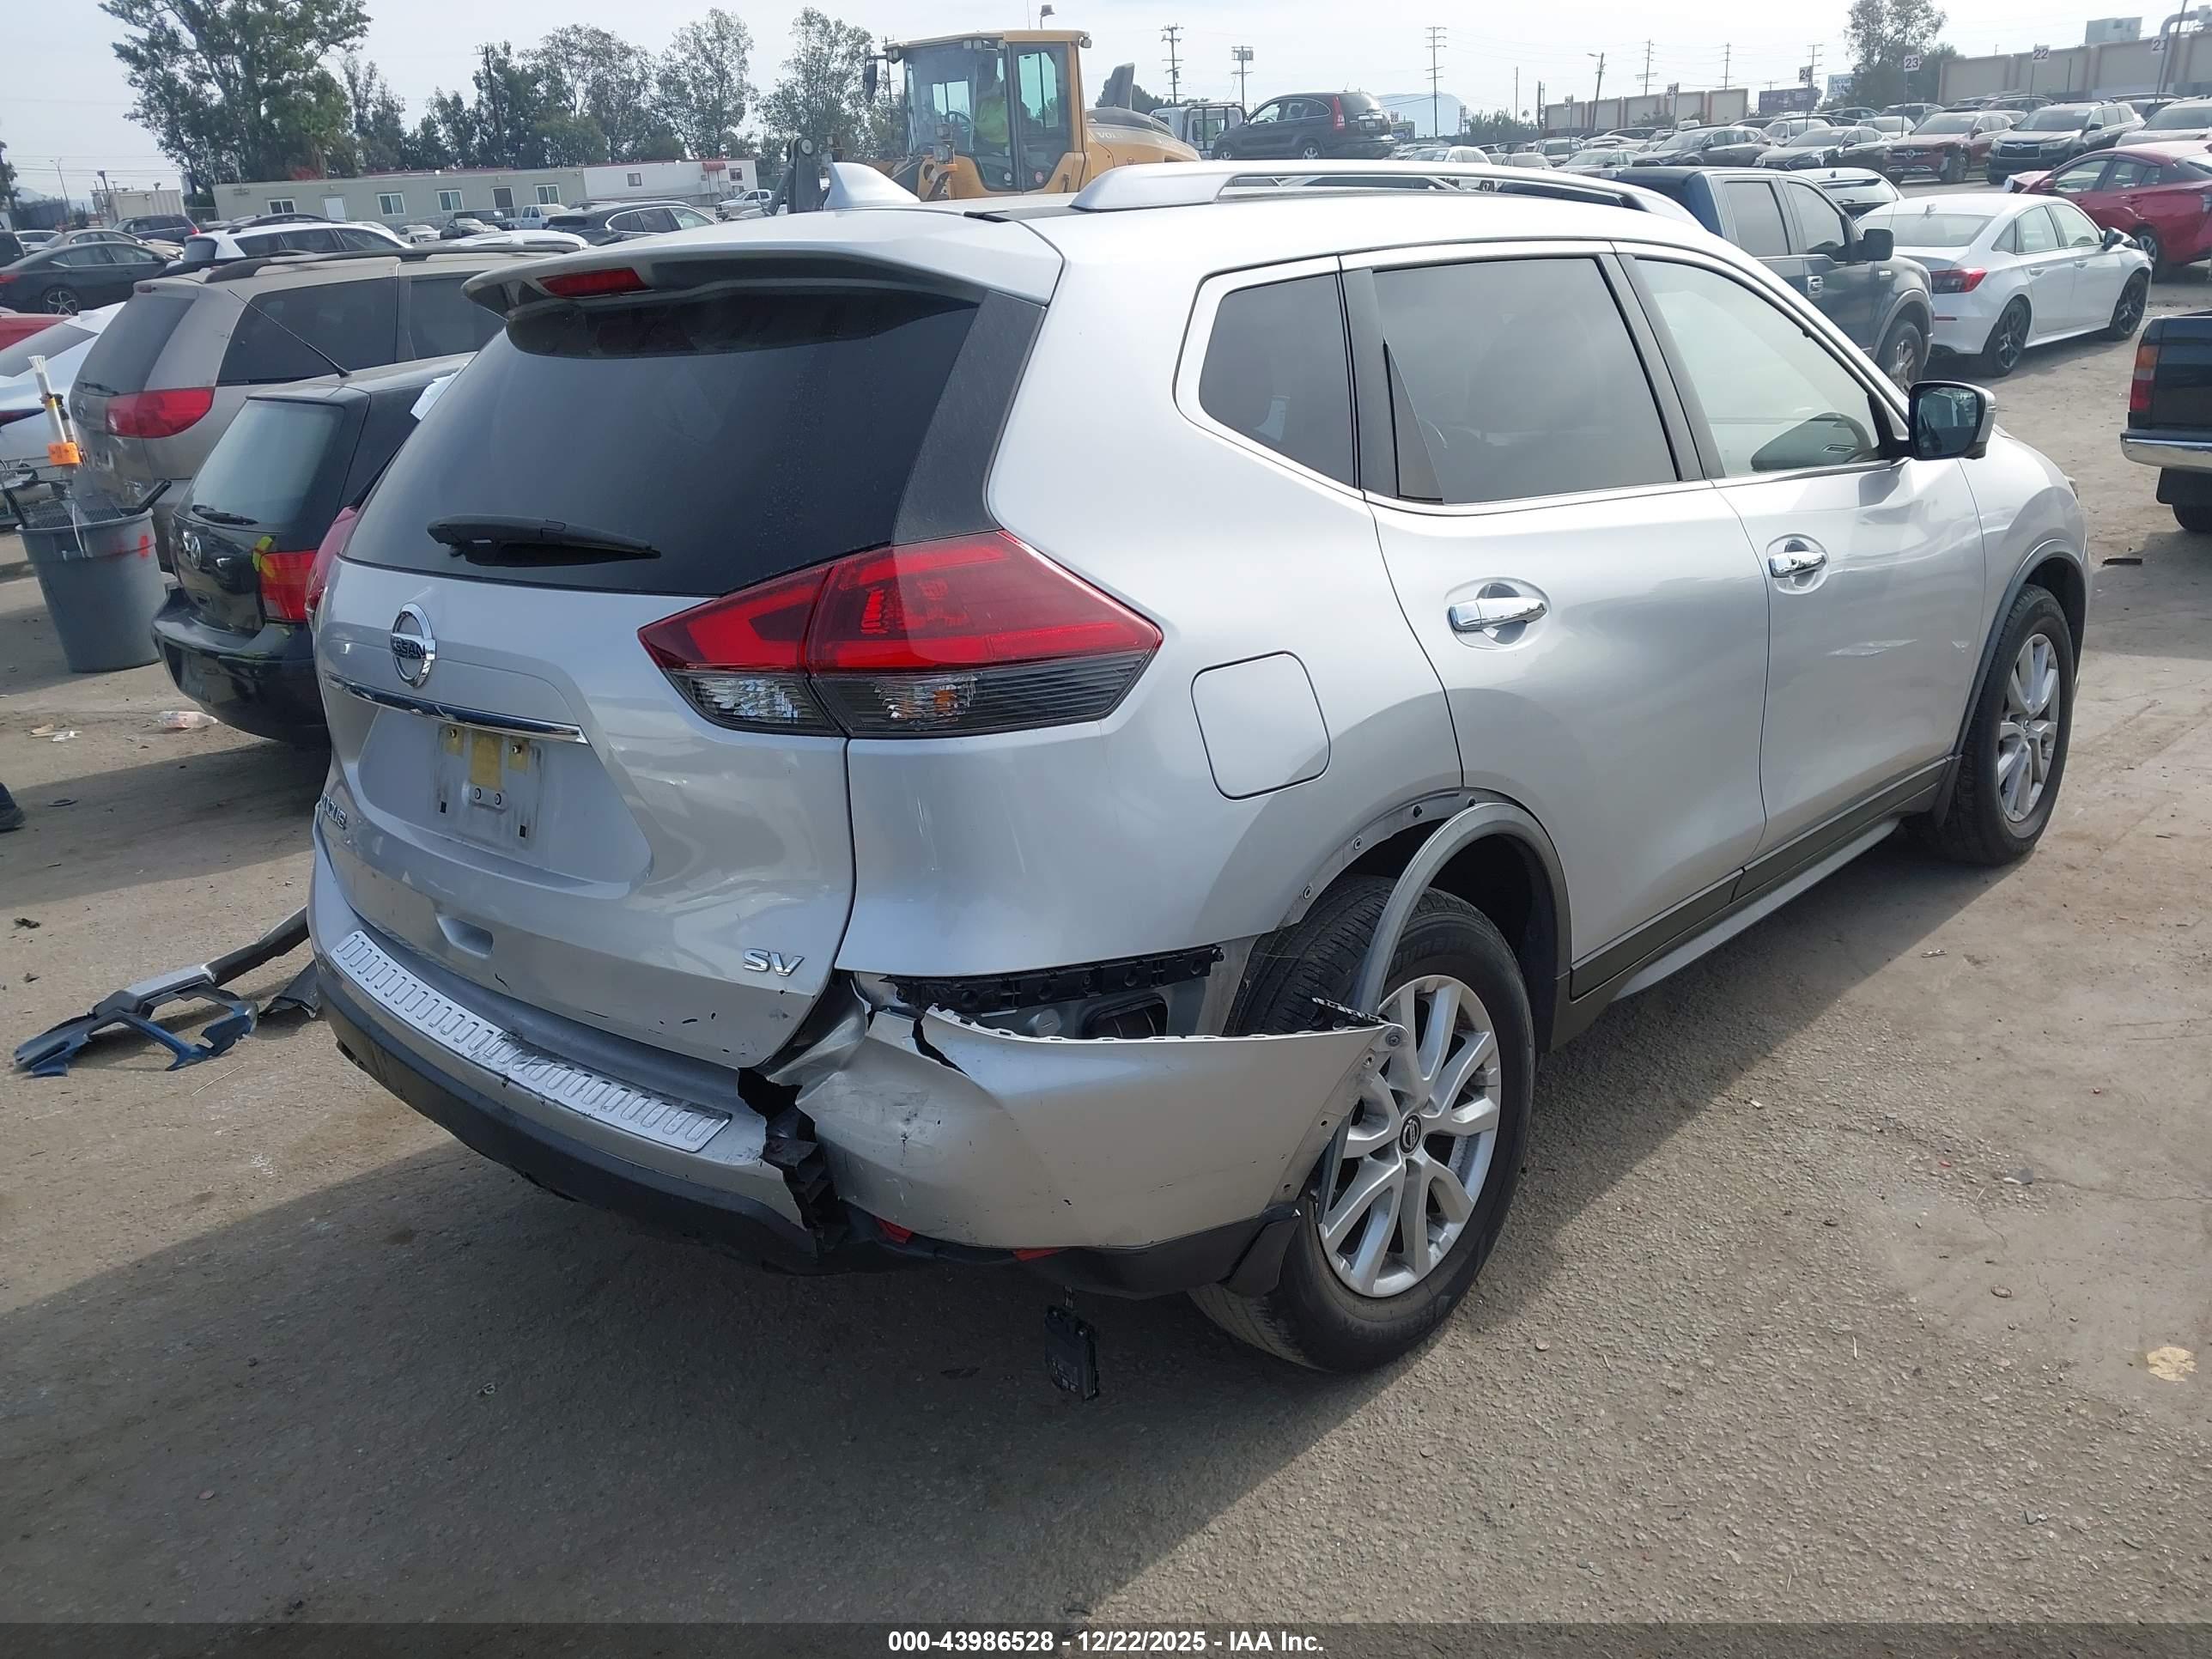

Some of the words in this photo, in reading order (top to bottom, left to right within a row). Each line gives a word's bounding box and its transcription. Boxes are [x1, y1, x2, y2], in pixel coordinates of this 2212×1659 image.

[2033, 47, 2050, 60] 22
[1905, 58, 1919, 70] 23
[1799, 70, 1812, 81] 24
[392, 636, 427, 657] SSAN
[743, 947, 805, 976] SV
